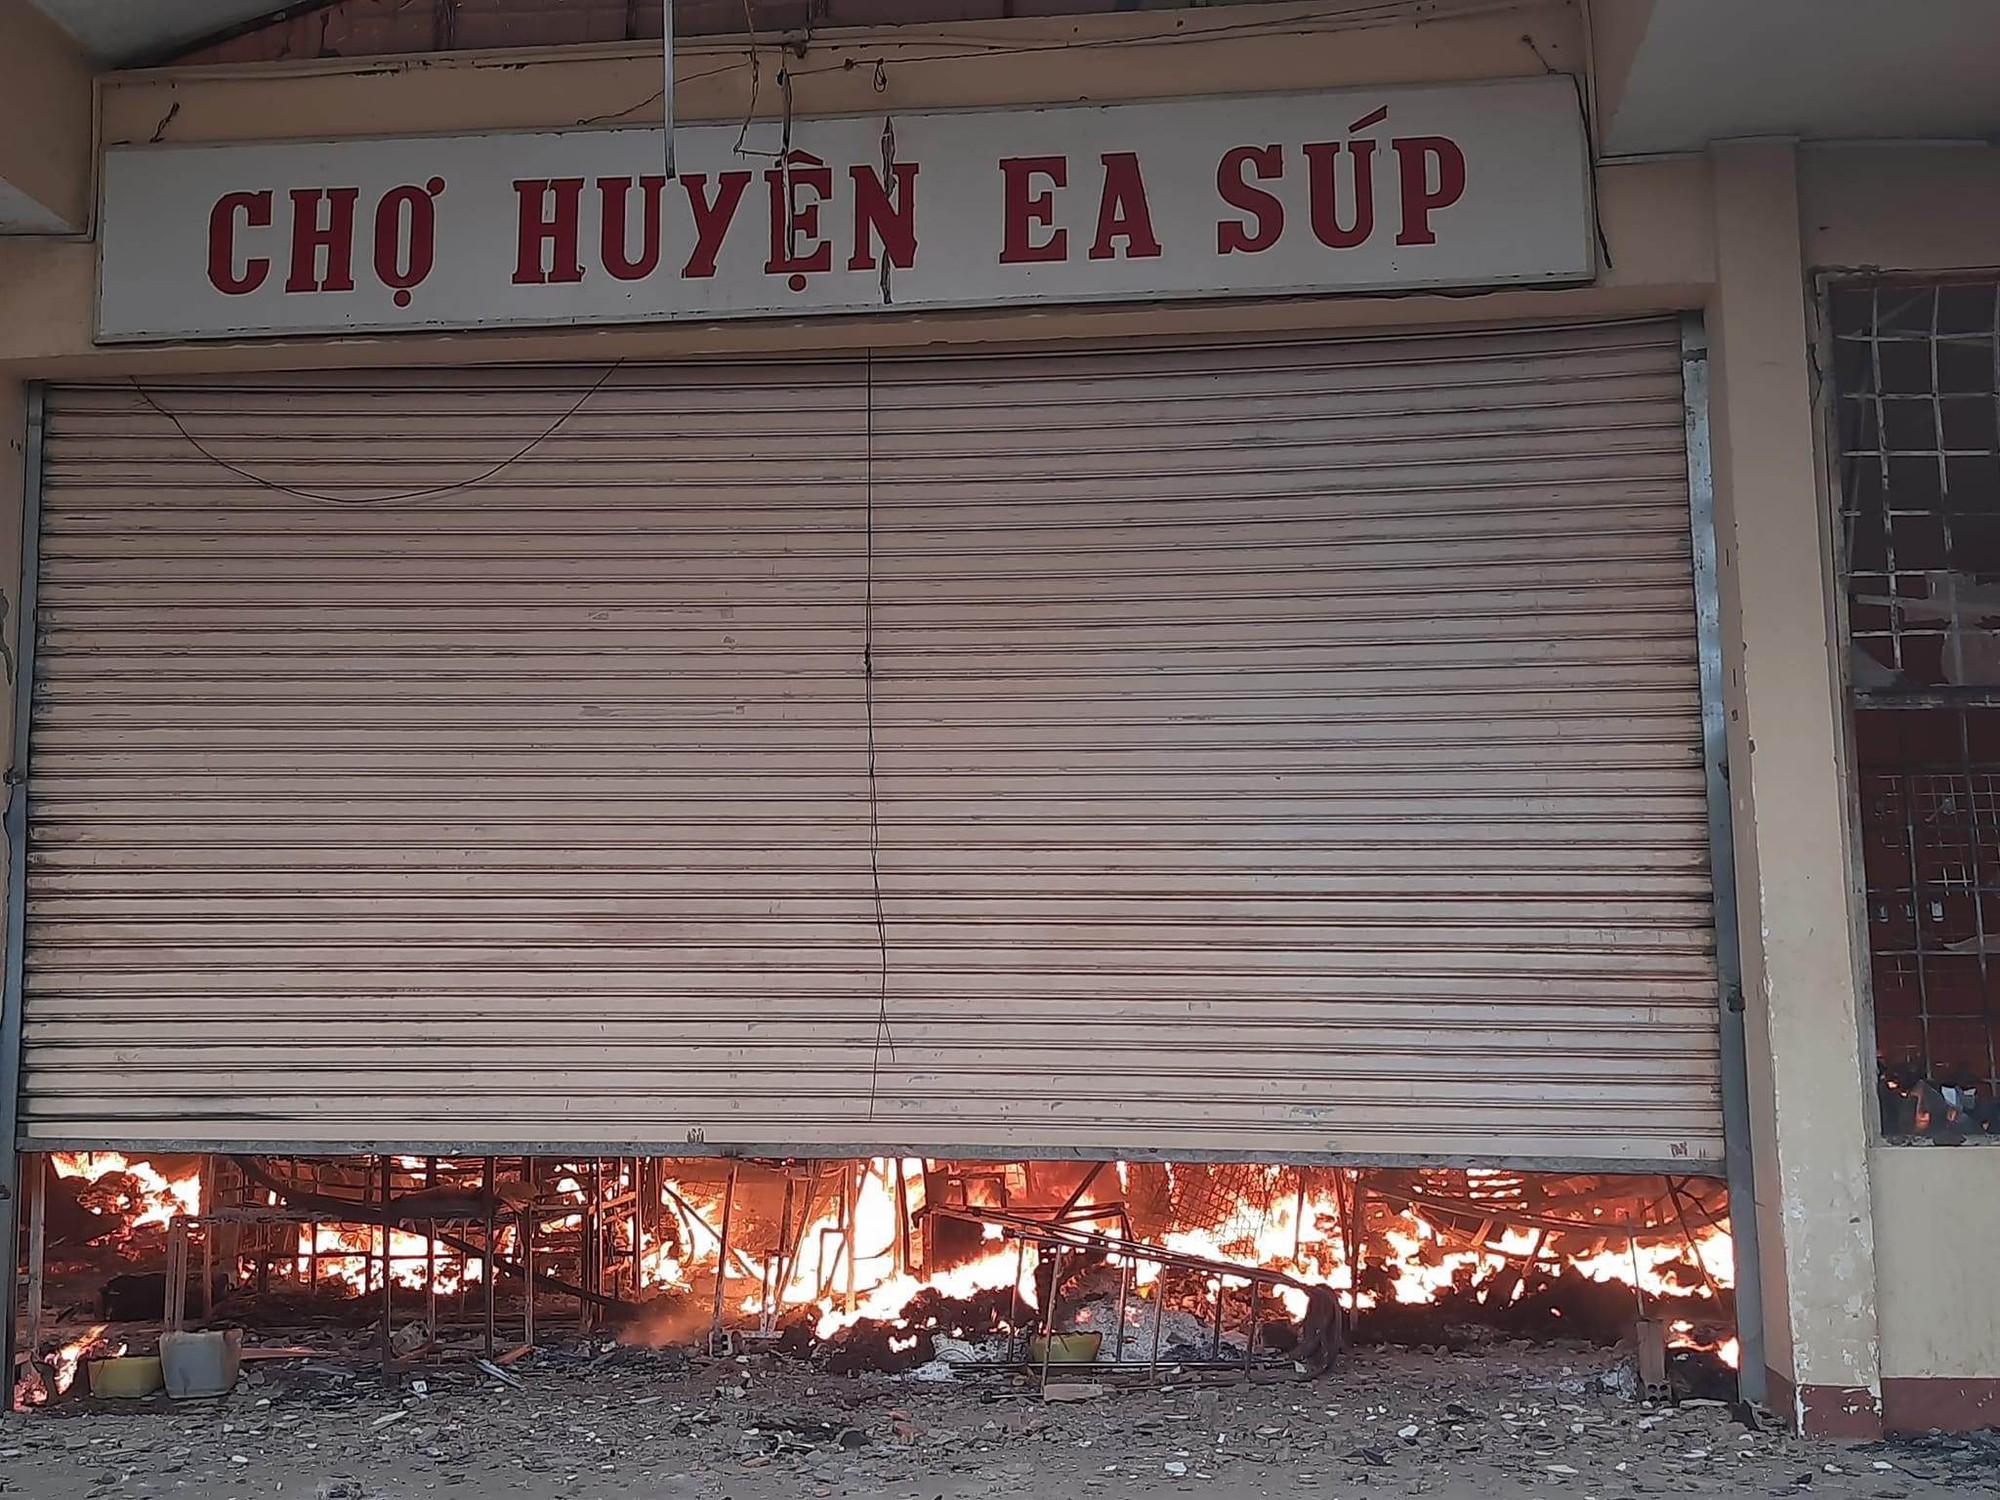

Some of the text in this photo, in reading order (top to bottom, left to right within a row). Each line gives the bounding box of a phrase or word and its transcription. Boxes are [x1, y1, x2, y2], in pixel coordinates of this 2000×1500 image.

[208, 104, 1467, 308] CHỢ HUYỆN EA SÚP
